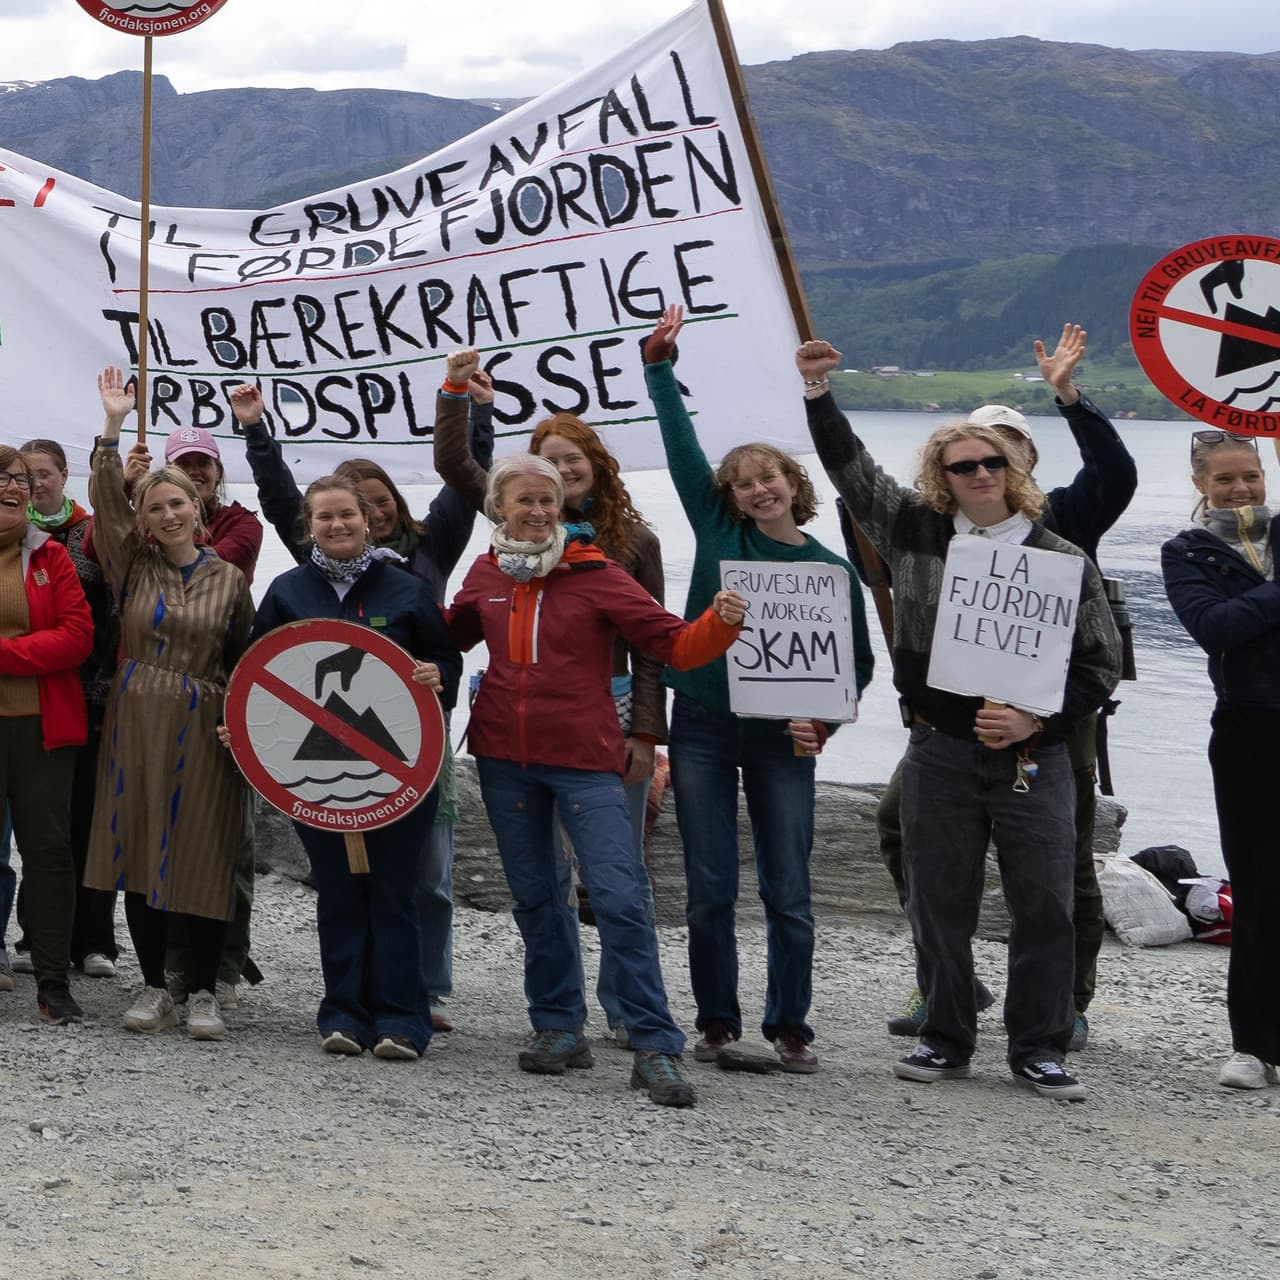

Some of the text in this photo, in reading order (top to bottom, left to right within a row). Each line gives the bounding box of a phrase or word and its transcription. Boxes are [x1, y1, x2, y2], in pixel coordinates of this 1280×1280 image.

[99, 2, 211, 33] fjordaksjonen.org
[102, 239, 730, 370] TIL BÆREKRAFTIGE
[1143, 280, 1169, 303] TIL
[1136, 307, 1159, 339] NEI
[1179, 388, 1280, 432] LA FØRD
[724, 570, 835, 597] GRUVESLAM
[989, 550, 1029, 584] LA
[761, 601, 832, 623] NOREGS
[949, 576, 1073, 627] FJORDEN
[733, 626, 840, 675] SKAM
[953, 613, 1042, 658] LEVE!
[292, 785, 419, 828] fjordaksjonen.org
